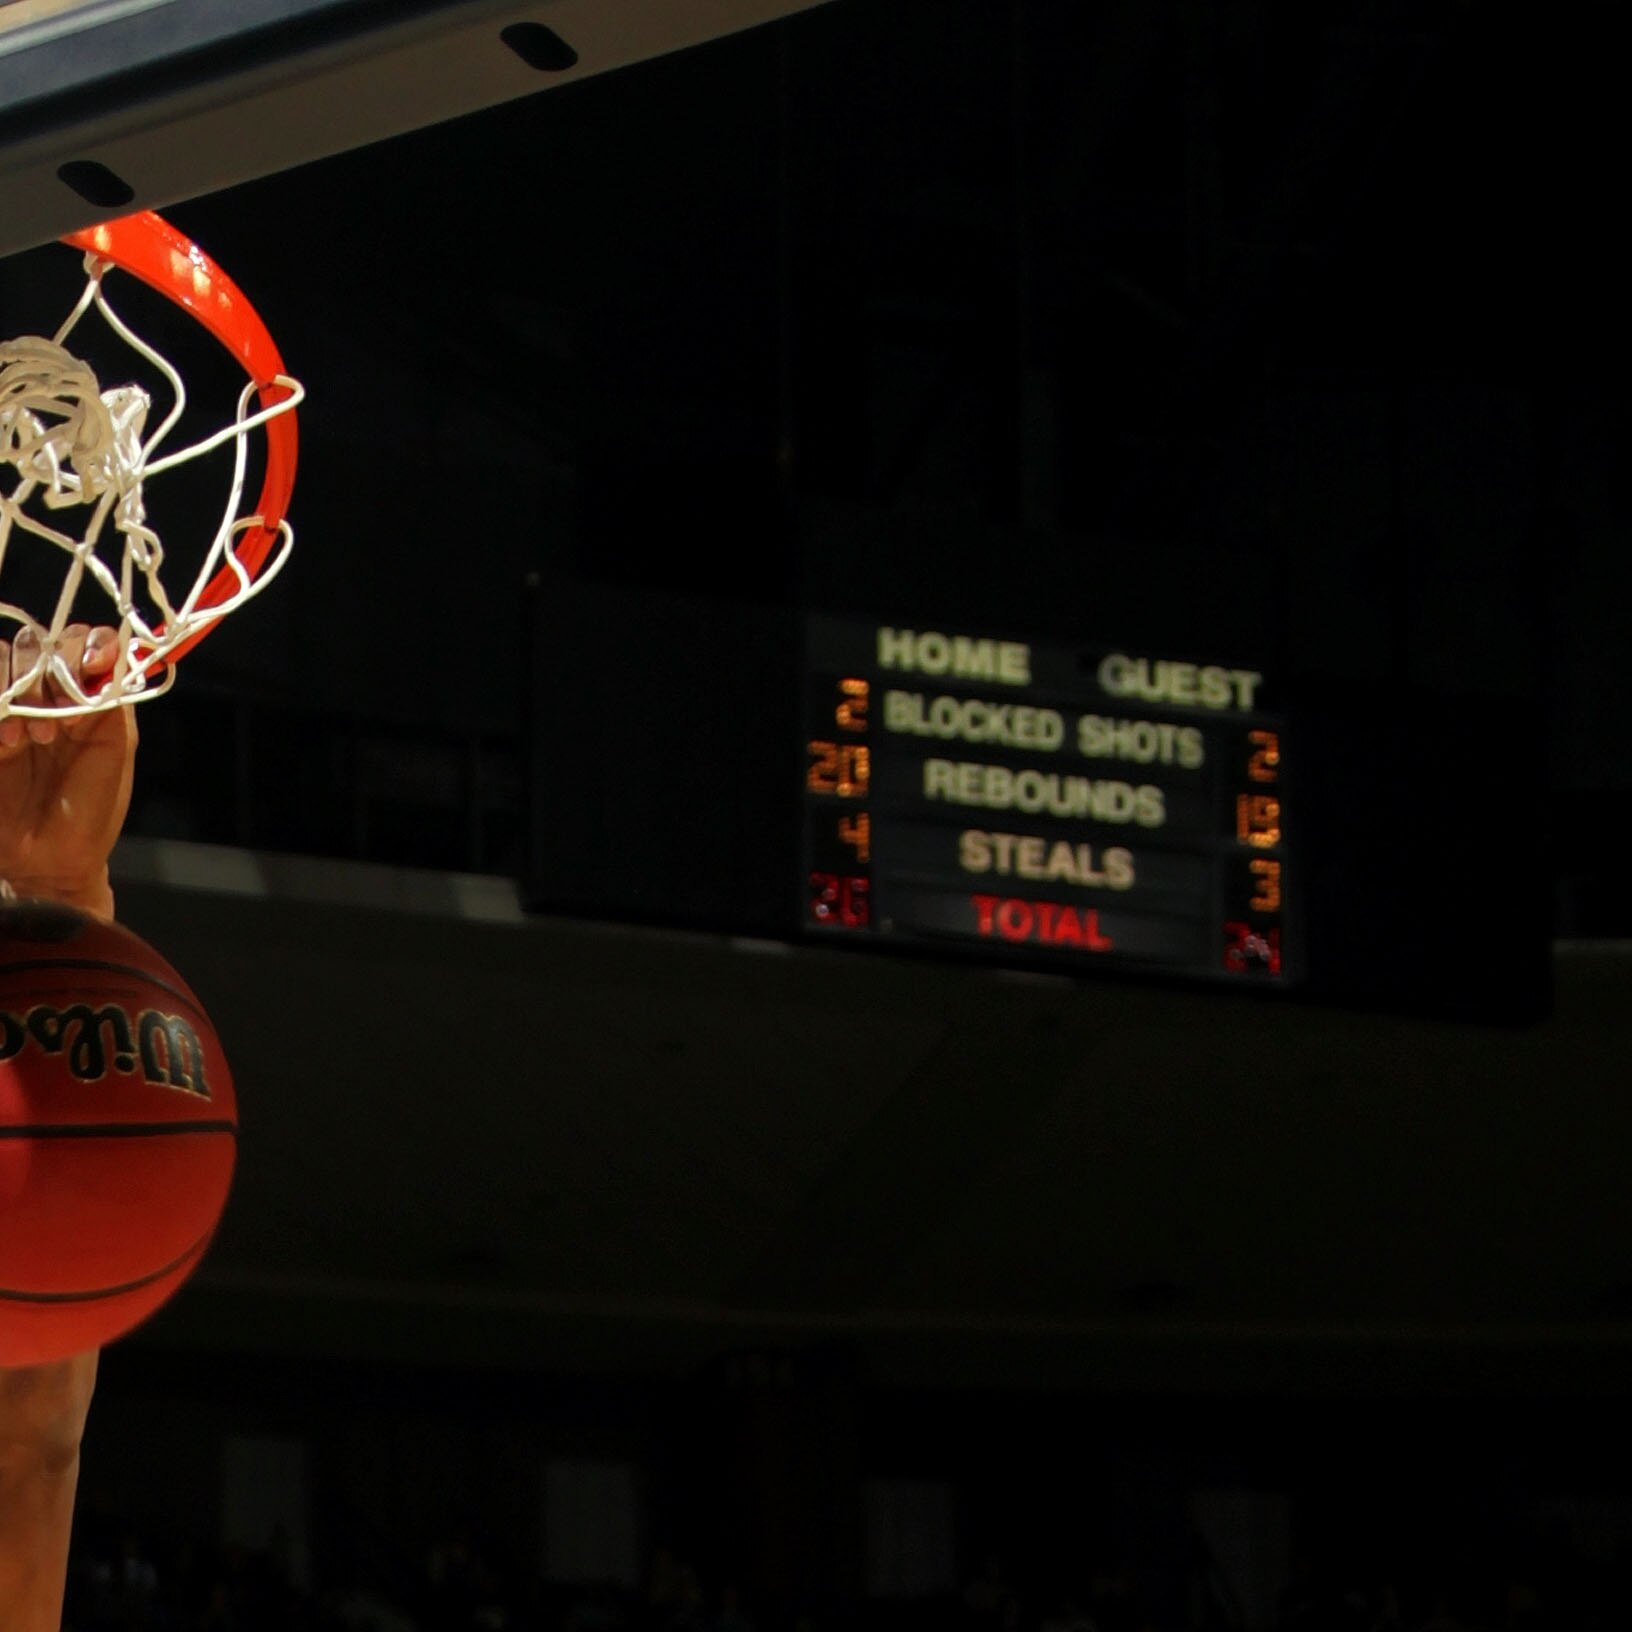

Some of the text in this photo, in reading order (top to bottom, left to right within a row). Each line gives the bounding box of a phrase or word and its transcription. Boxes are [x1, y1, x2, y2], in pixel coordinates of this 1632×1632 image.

[877, 627, 1262, 710] HOME GUEST
[836, 679, 869, 732] 2
[883, 690, 1204, 769] BLOCKED SHOTS
[1248, 731, 1280, 782] 2
[923, 758, 1165, 828] REBOUNDS
[838, 812, 870, 863] 4
[959, 830, 1135, 891] STEALS
[1248, 859, 1280, 911] 3
[970, 894, 1112, 952] TOTAL
